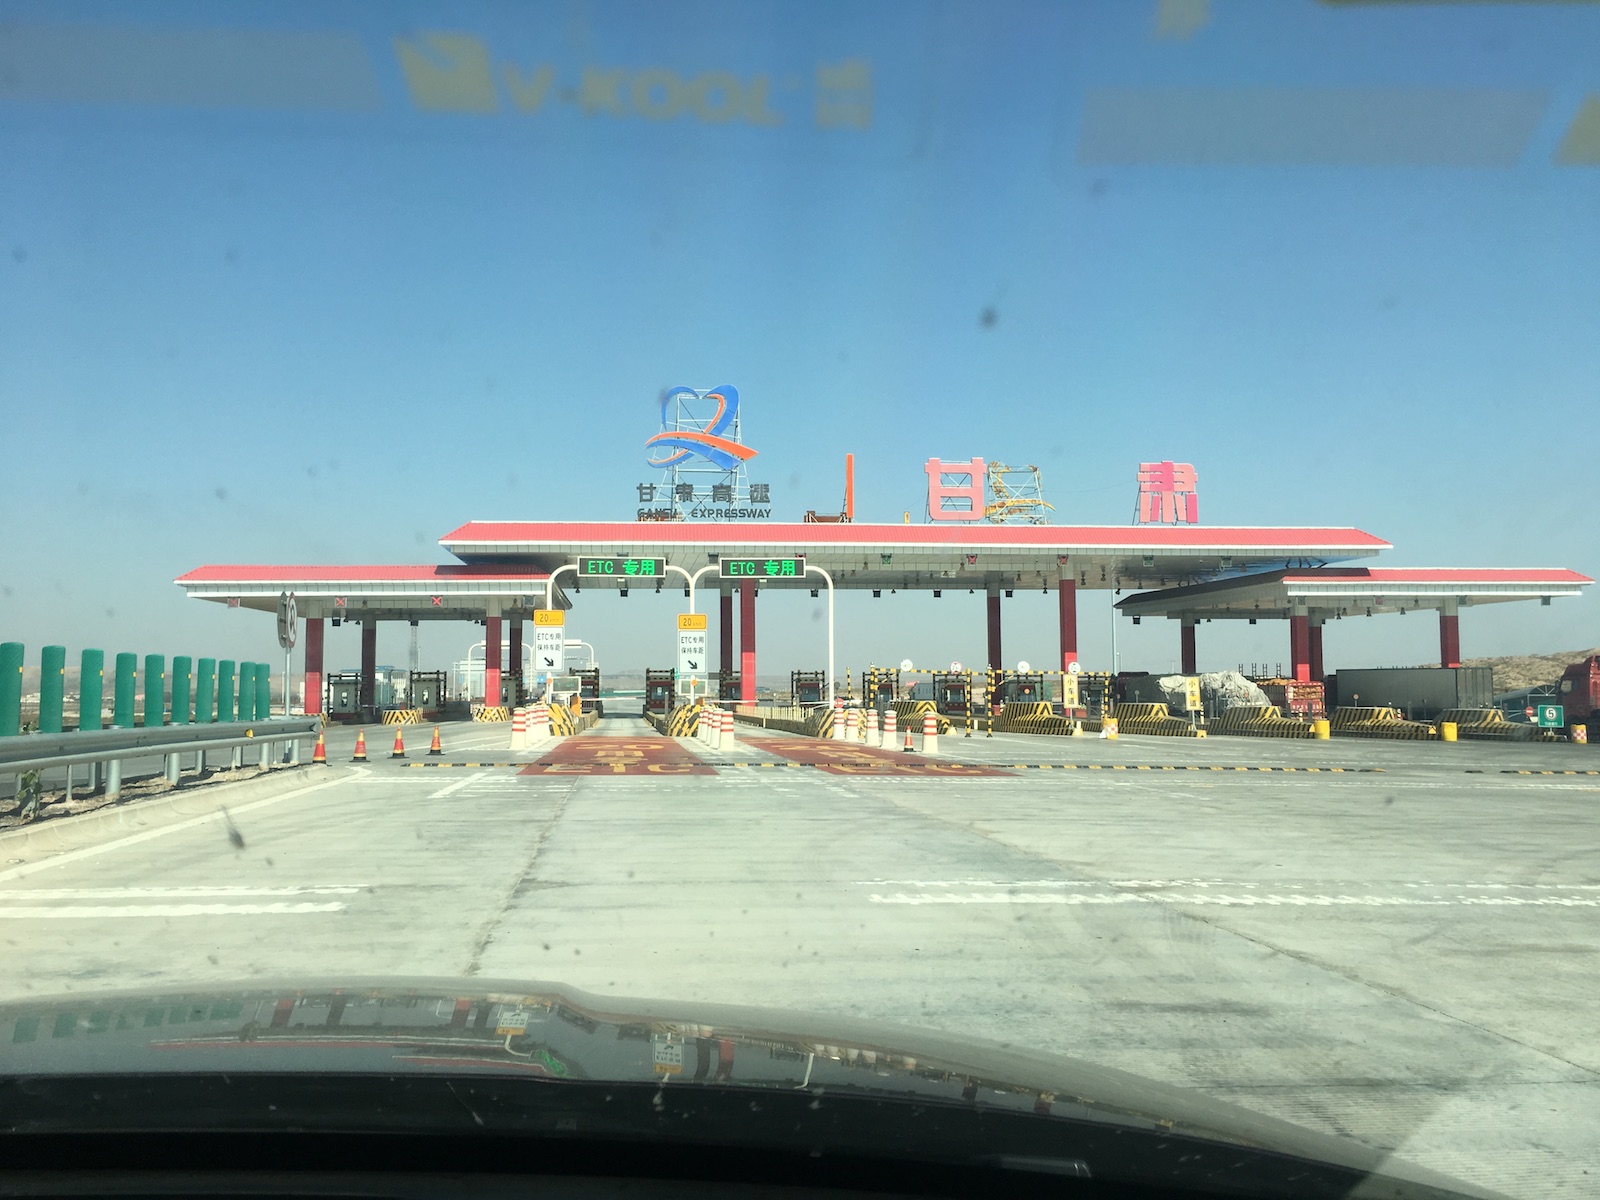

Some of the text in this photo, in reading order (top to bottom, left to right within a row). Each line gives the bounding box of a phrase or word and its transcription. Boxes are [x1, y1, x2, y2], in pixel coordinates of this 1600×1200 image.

[636, 482, 771, 505] 甘肃高速
[690, 508, 772, 519] EXPRESSWAY
[588, 559, 655, 576] ETC 专用
[730, 559, 796, 576] ETC 专用
[539, 613, 549, 622] 20
[683, 617, 692, 627] 20
[1066, 677, 1075, 706] 小车道
[1188, 680, 1197, 707] 小车道
[1548, 709, 1555, 719] 5
[543, 763, 694, 773] ETC
